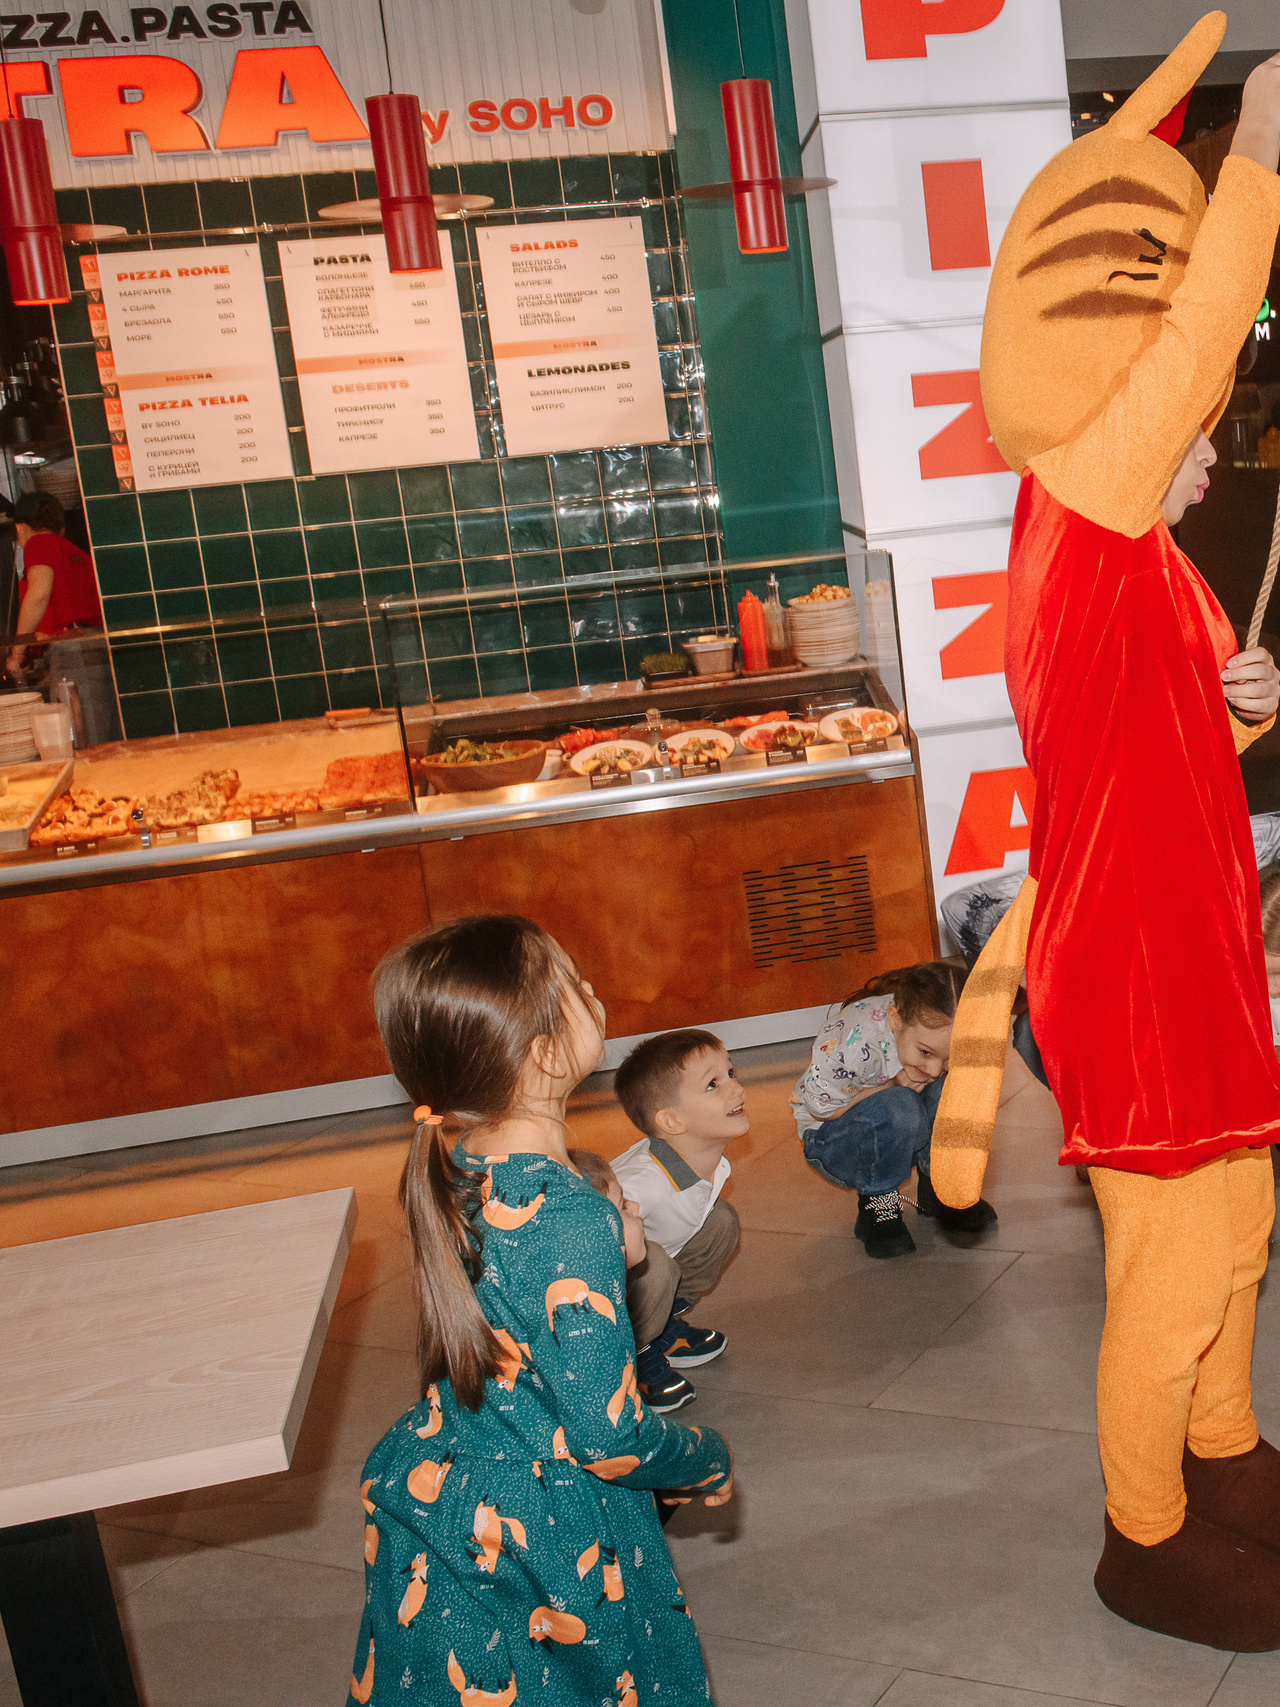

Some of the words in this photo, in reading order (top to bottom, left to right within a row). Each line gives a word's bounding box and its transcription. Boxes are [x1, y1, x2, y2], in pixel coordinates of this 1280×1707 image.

[468, 94, 613, 133] SOHO
[510, 239, 578, 252] SALADS
[313, 254, 372, 265] PASTA
[512, 259, 552, 267] ВИТЕЛЛО
[117, 269, 172, 281] PIZZA
[178, 265, 230, 277] ROME
[513, 264, 566, 273] РОСТБИФОМ
[316, 272, 368, 281] БОЛОНЬЕЗЕ
[515, 279, 552, 287] КАПРЕЗЕ
[119, 287, 172, 297] МАРГАРИТА
[317, 285, 375, 294] СПАГЕТТОНИ
[554, 289, 598, 298] ИНЖИРОМ
[318, 292, 371, 301] КАРБОНАРА
[527, 298, 558, 307] СЫРОМ
[320, 304, 368, 313] ФЕТУЧИНИ
[321, 310, 369, 319] АЛЬФРЕДО
[519, 312, 552, 321] ЦЕЗАРЬ
[124, 318, 172, 327] БРЕЗАОЛА
[323, 322, 373, 332] КАЗАРЕЧЧЕ
[332, 328, 379, 337] МИДИЯМИ
[127, 334, 152, 342] МОРЕ
[553, 341, 597, 349] MOSTRA
[359, 356, 404, 365] MOSTRA
[527, 361, 631, 377] LEMONADES
[166, 372, 213, 382] MOSTRA
[332, 380, 409, 394] DESERTS
[530, 385, 605, 397] БАЗИЛИК/ЛИМОН
[139, 399, 193, 411] PIZZA
[198, 394, 249, 407] TELIA
[335, 402, 396, 413] ПРОФИТРОЛИ
[532, 403, 565, 412] ЦИТРУС
[156, 420, 181, 428] SOHO
[337, 418, 384, 428] ТИРАМИСУ
[144, 433, 195, 443] СИЦИЛИЕЦ
[237, 427, 253, 435] 200
[339, 433, 378, 442] КАПРЕЗЕ
[147, 448, 195, 457] ПЕПЕРОНИ
[157, 460, 199, 470] КУРИЦЕЙ
[241, 455, 258, 463] 200
[158, 468, 201, 477] ГРИБАМИ
